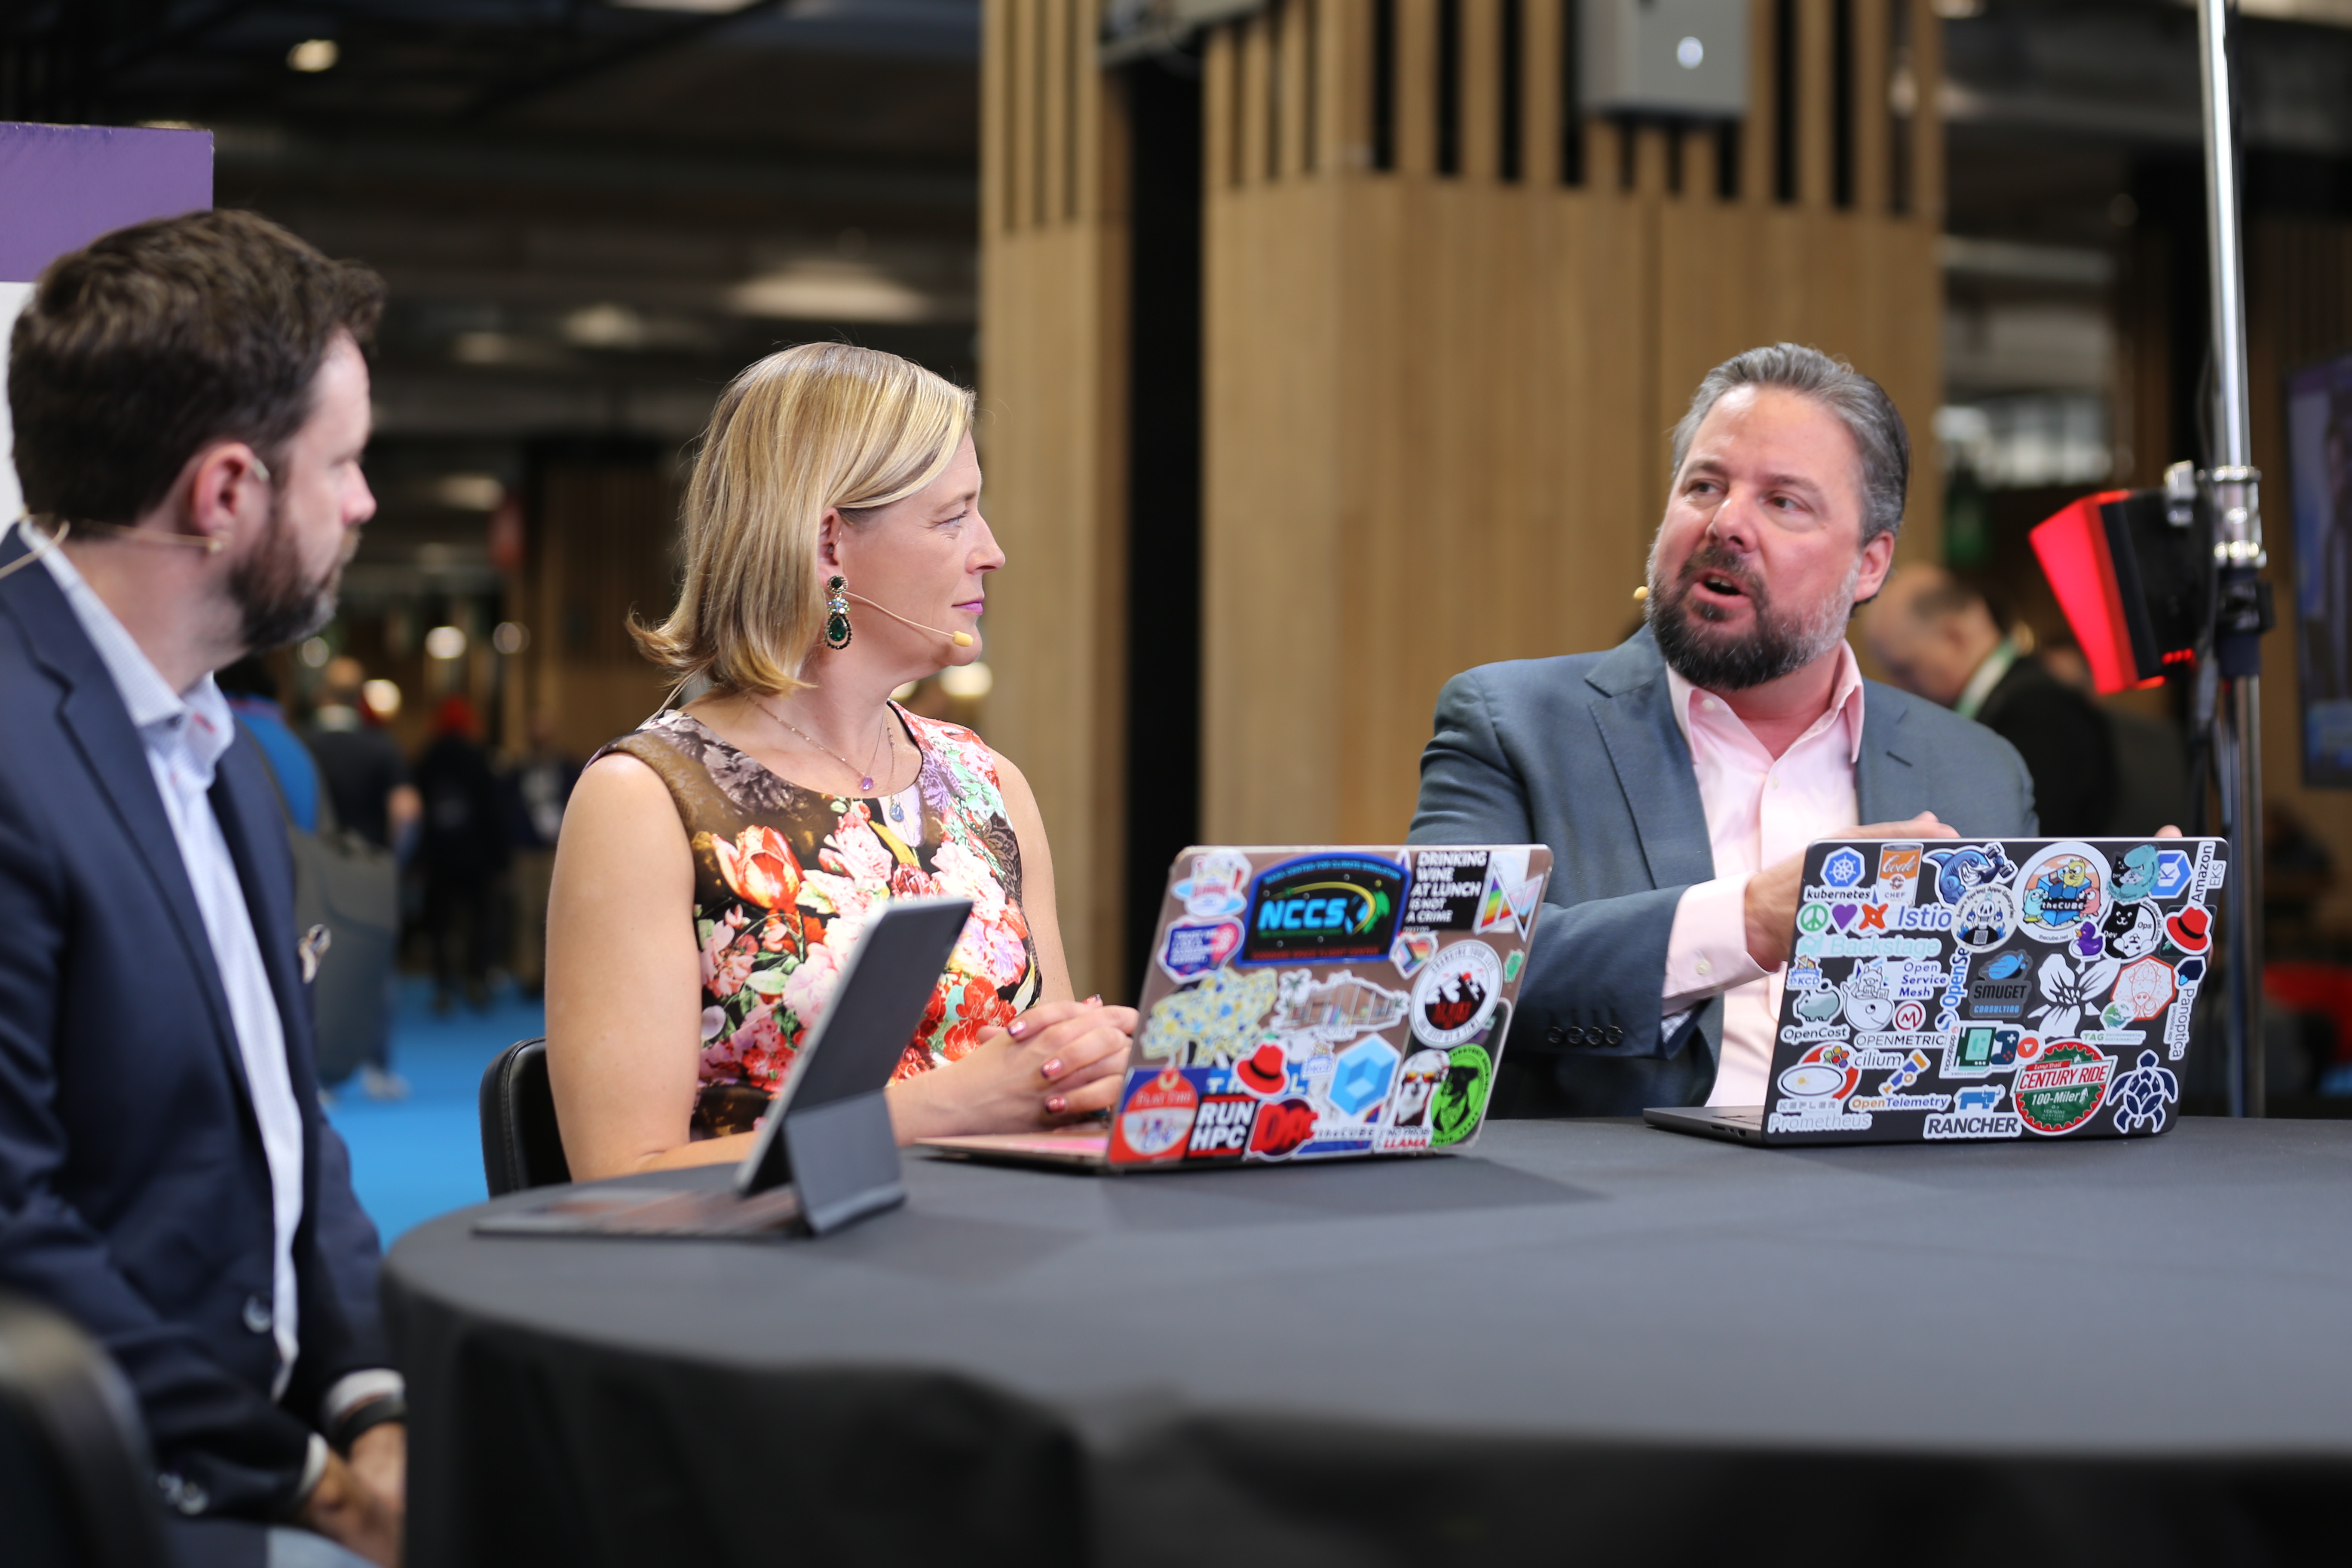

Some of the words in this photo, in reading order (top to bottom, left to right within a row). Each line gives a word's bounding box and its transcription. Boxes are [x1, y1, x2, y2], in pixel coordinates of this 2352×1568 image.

[1418, 851, 1487, 867] DRINKING
[1882, 854, 1917, 873] Code
[1416, 867, 1455, 882] WINE
[2191, 845, 2213, 903] Amazon
[2209, 864, 2223, 885] EKS
[1410, 882, 1431, 897] AT
[1430, 882, 1482, 897] LUNCH
[1807, 888, 1870, 899] kubernetes
[1966, 888, 1986, 900] Spring
[1408, 898, 1420, 911] IS
[1420, 897, 1447, 910] NOT
[2043, 901, 2084, 910] theCUBE
[1257, 898, 1348, 930] NCCS
[1405, 911, 1416, 923] A
[1416, 910, 1453, 923] CRIME
[1898, 906, 1952, 927] Istio
[2138, 921, 2152, 930] Ops
[2104, 930, 2118, 938] Dev
[1831, 936, 1939, 958] Backstage
[1904, 962, 1938, 974] Open
[1902, 975, 1947, 984] Service
[1899, 987, 1930, 997] Mesh
[1974, 985, 2027, 999] SMUGET
[1974, 1005, 2020, 1014] CONSULTING
[2173, 988, 2194, 1057] Panoptica
[1784, 1027, 1847, 1041] OpenCost
[1856, 1035, 1946, 1046] OPENMETRIC
[1854, 1053, 1902, 1066] cilium
[1945, 1035, 1956, 1071] databricks
[2020, 1069, 2079, 1089] CENTURY
[2078, 1065, 2109, 1083] RIDE
[1779, 1100, 1837, 1109] KEPLER
[1852, 1097, 1948, 1109] OpenTelemetry
[2032, 1091, 2081, 1106] 100-Miler
[1196, 1101, 1256, 1126] RUN
[1770, 1113, 1870, 1130] Prometheus
[1928, 1117, 2018, 1134] RANCHER
[1189, 1124, 1247, 1150] HPC
[1403, 1126, 1430, 1135] PROB
[1384, 1139, 1427, 1148] LLAMA
